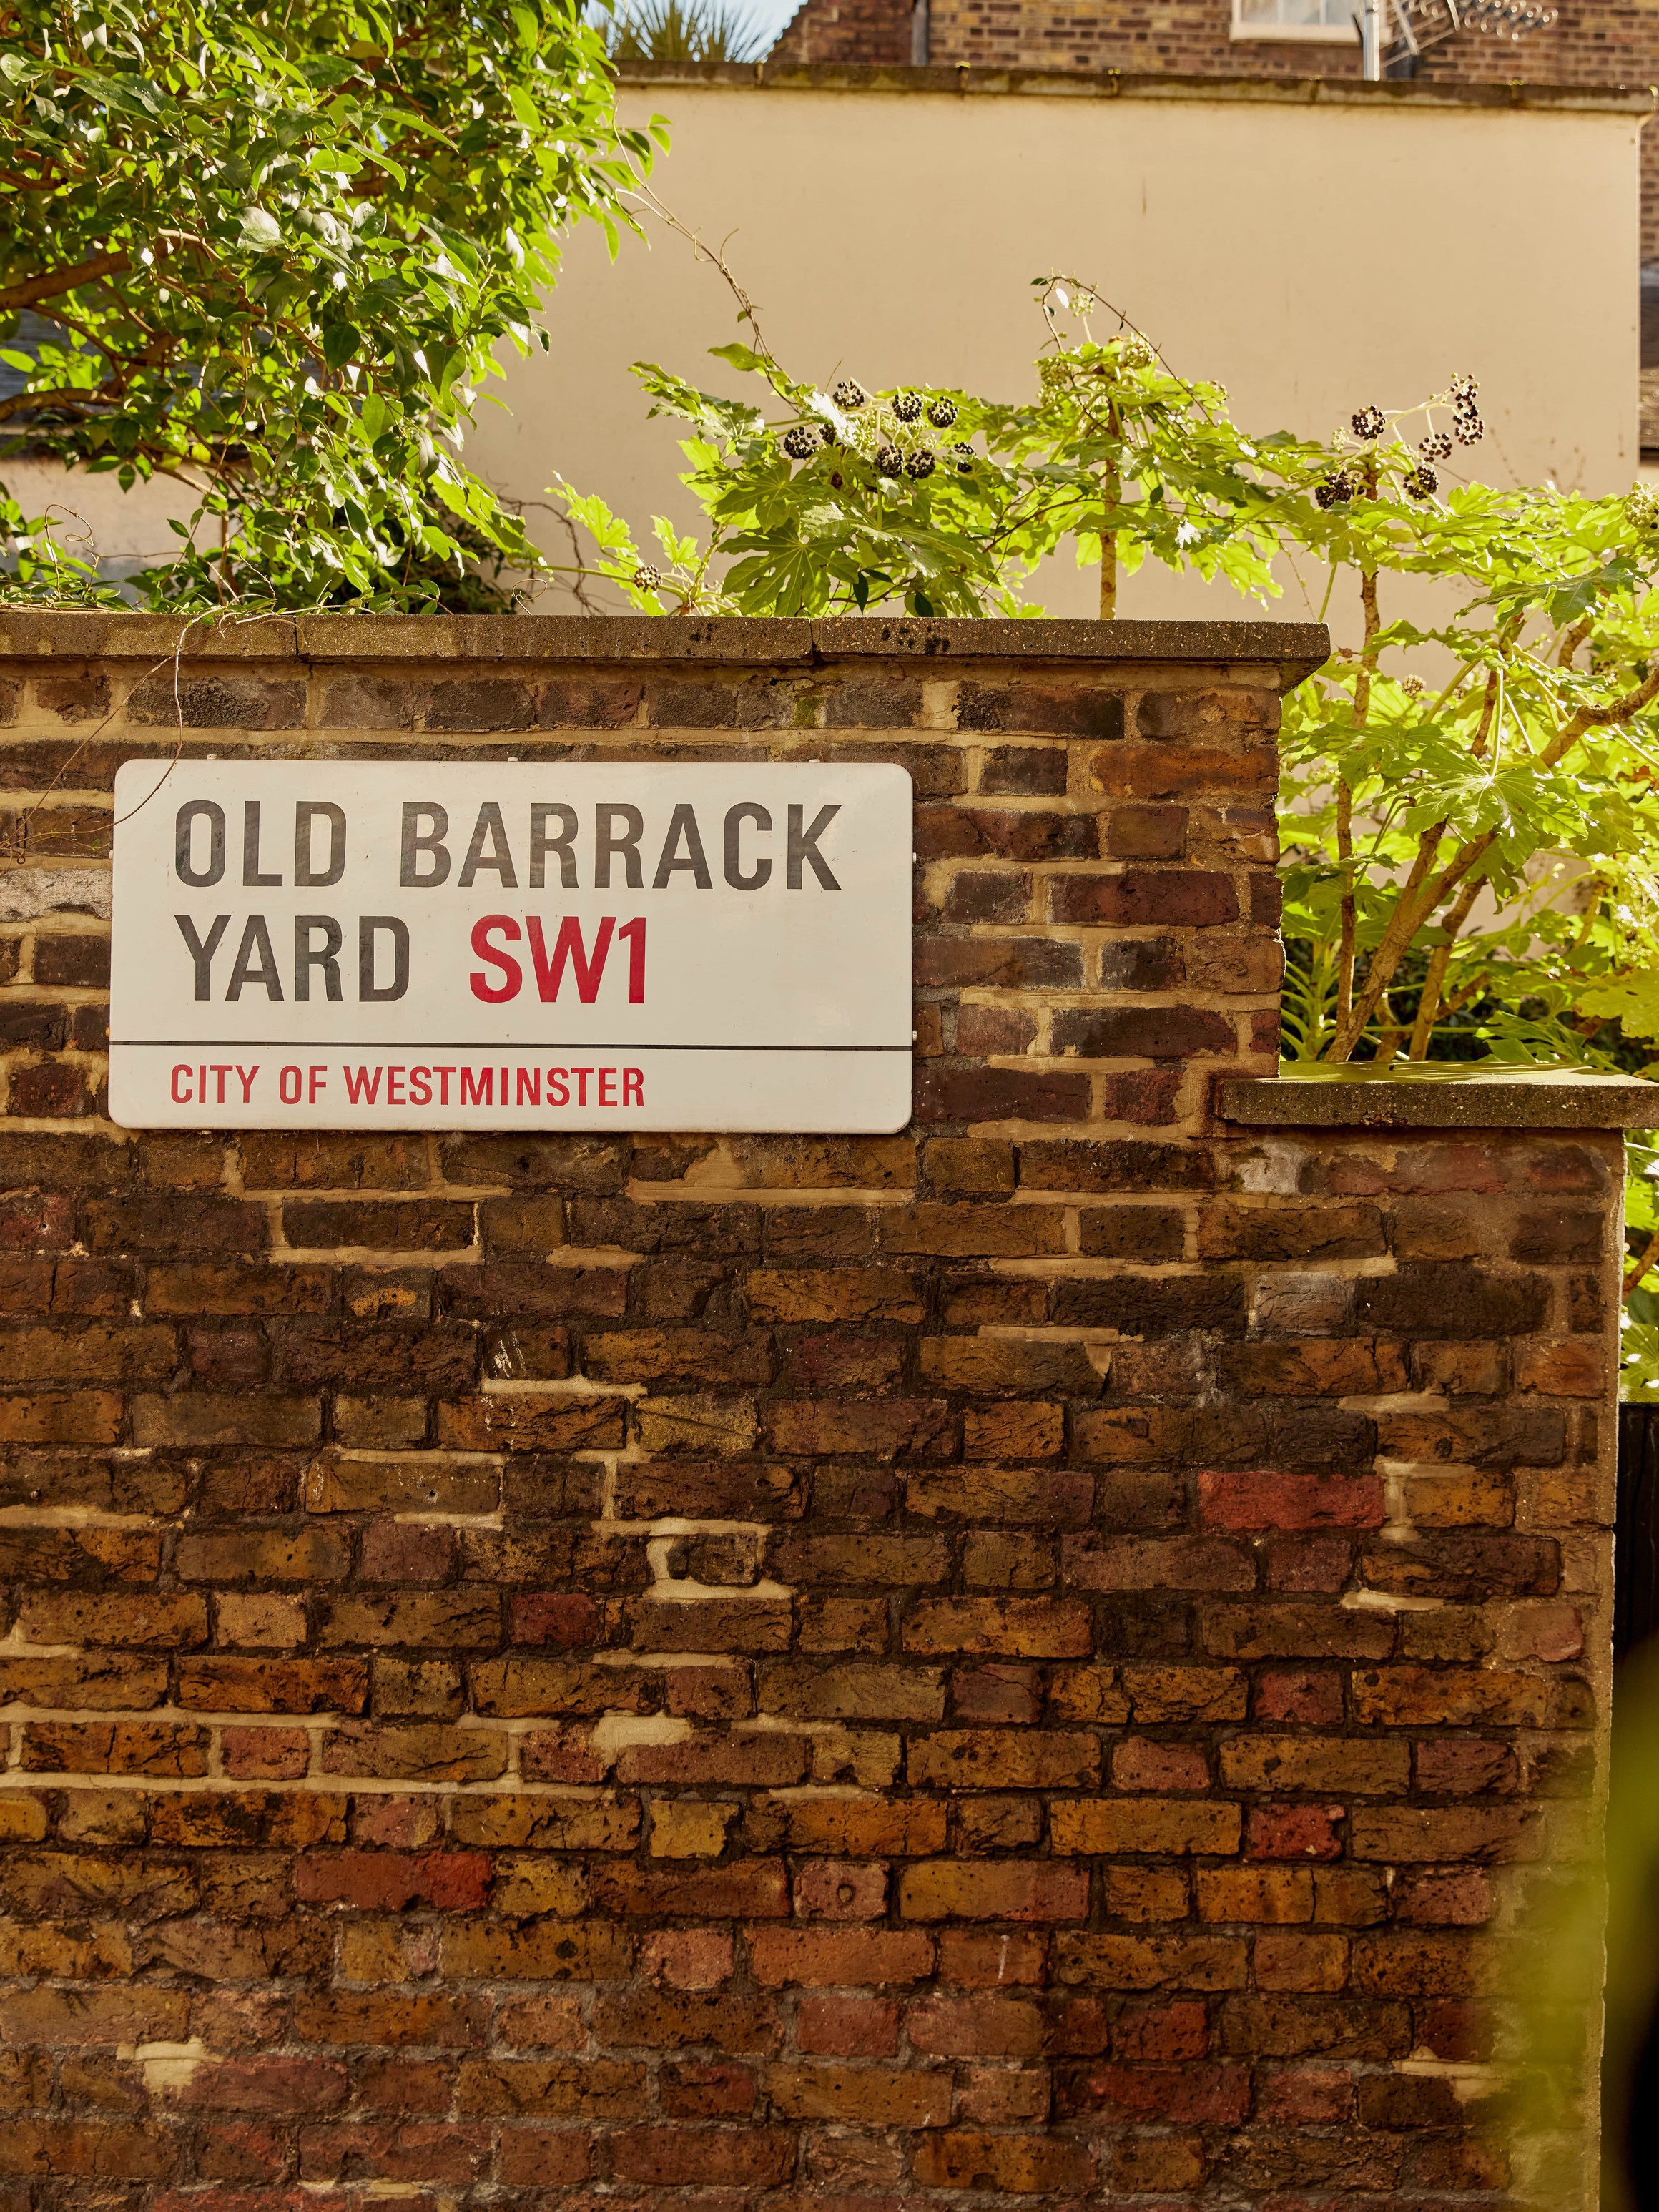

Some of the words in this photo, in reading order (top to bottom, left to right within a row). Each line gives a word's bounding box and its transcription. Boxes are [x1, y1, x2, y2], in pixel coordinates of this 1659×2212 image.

[175, 799, 346, 888] OLD
[400, 802, 842, 891] BARRACK
[174, 914, 410, 1003] YARD
[470, 914, 646, 1004] SW1
[171, 1064, 260, 1104] CITY
[280, 1066, 328, 1105] OF
[343, 1066, 645, 1107] WESTMINSTER
